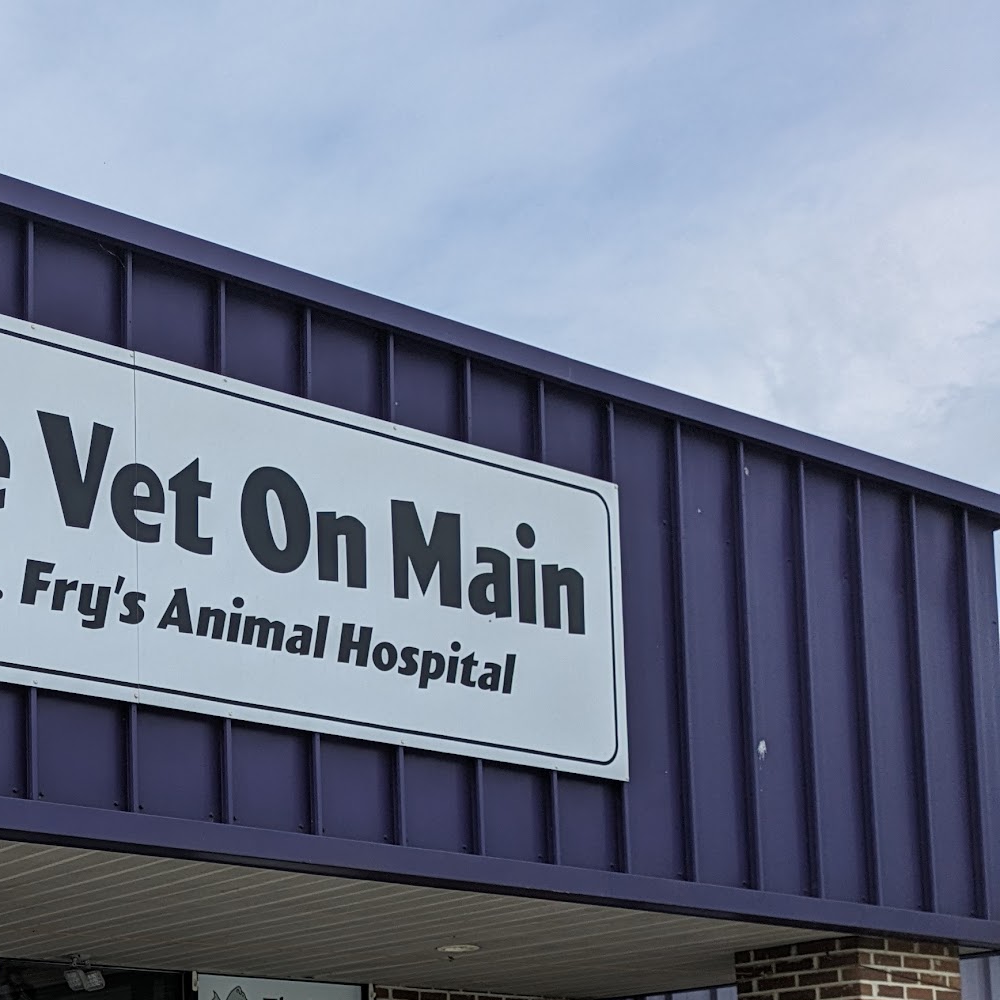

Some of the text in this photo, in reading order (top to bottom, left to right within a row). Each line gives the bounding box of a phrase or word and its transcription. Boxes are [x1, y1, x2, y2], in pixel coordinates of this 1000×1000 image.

[37, 410, 213, 555] Vet
[241, 466, 367, 589] On
[391, 499, 585, 635] Main
[20, 559, 146, 629] Fry's
[157, 588, 330, 658] Animal
[338, 623, 516, 694] Hospital
